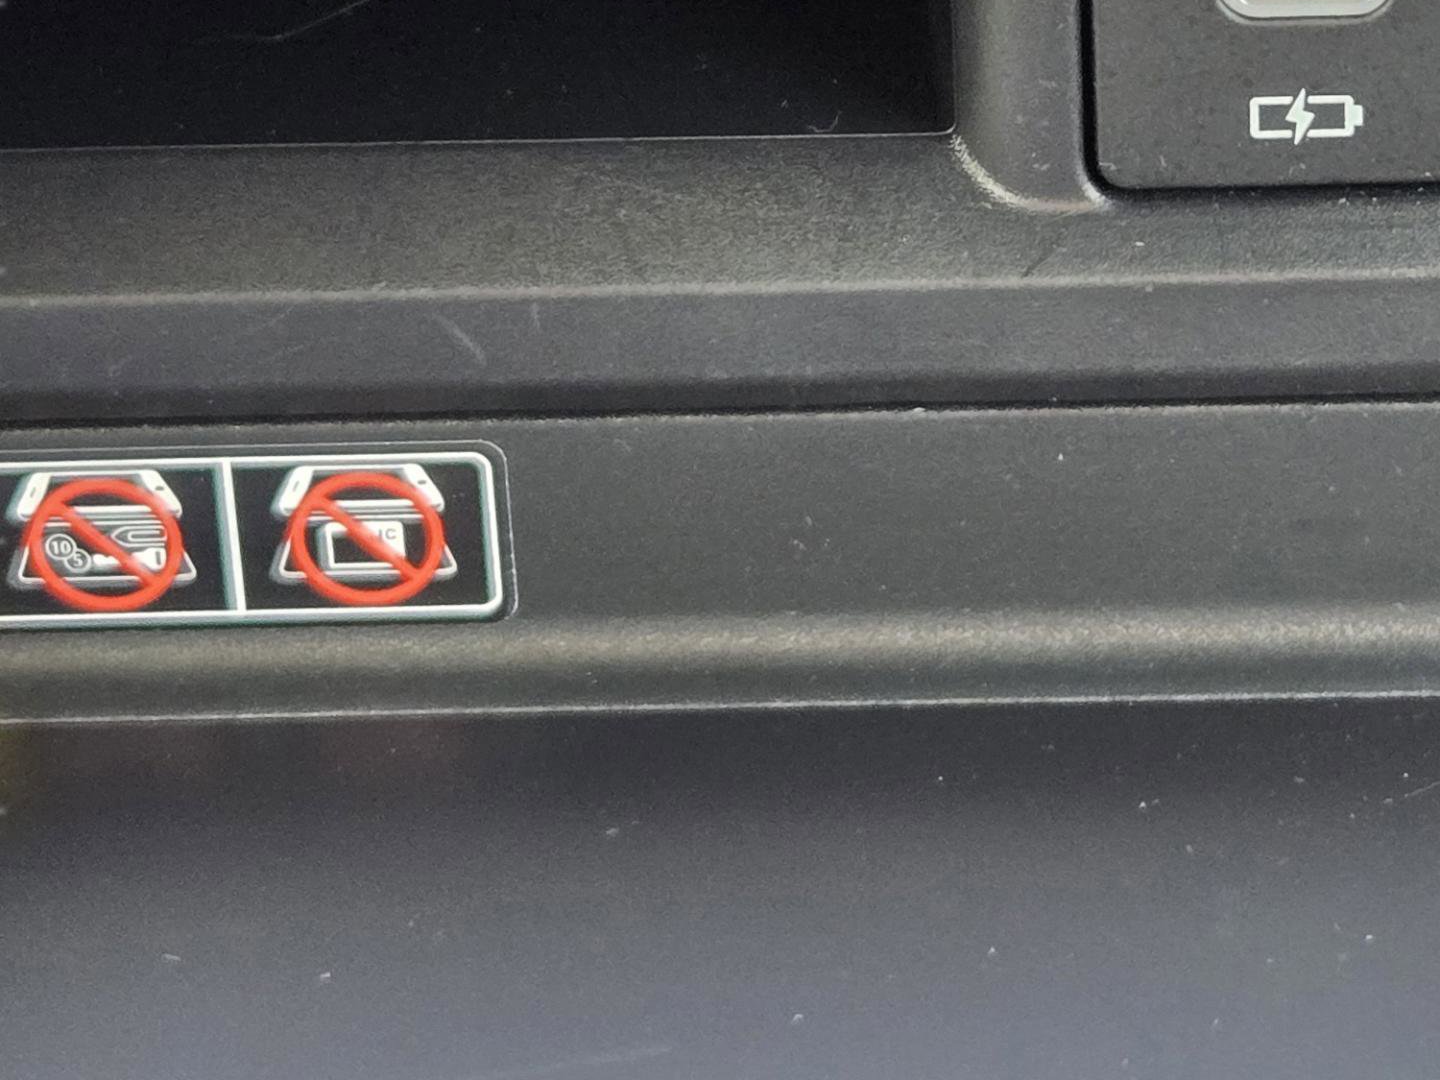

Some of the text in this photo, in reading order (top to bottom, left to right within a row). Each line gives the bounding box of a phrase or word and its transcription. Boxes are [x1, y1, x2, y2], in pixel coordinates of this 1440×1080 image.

[378, 528, 397, 541] IC
[52, 540, 71, 555] 10
[73, 552, 83, 567] 5
